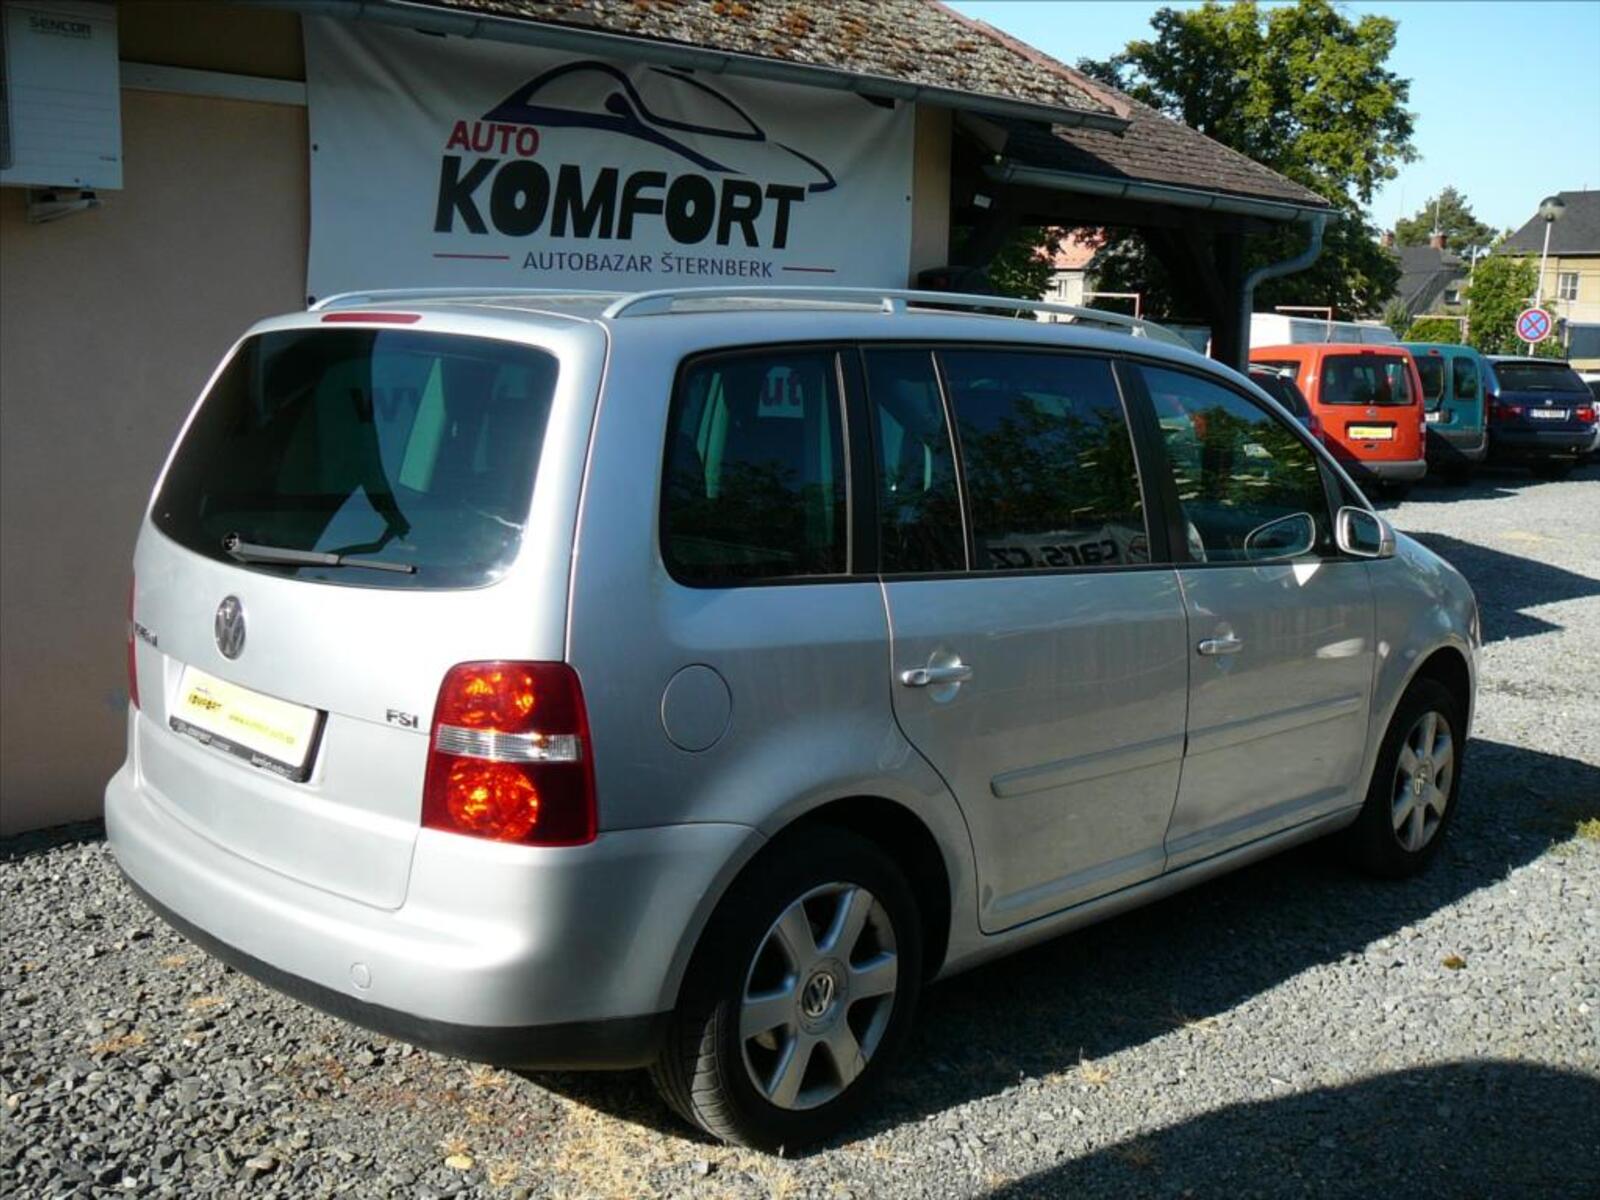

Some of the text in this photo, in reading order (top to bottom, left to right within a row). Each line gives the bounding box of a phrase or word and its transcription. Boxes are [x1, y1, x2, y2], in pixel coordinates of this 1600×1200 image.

[445, 120, 540, 157] AUTO
[434, 155, 806, 249] KOMFORT
[523, 250, 773, 279] AUTOBAZAR ŠTERNBERK
[386, 708, 419, 729] FSI
